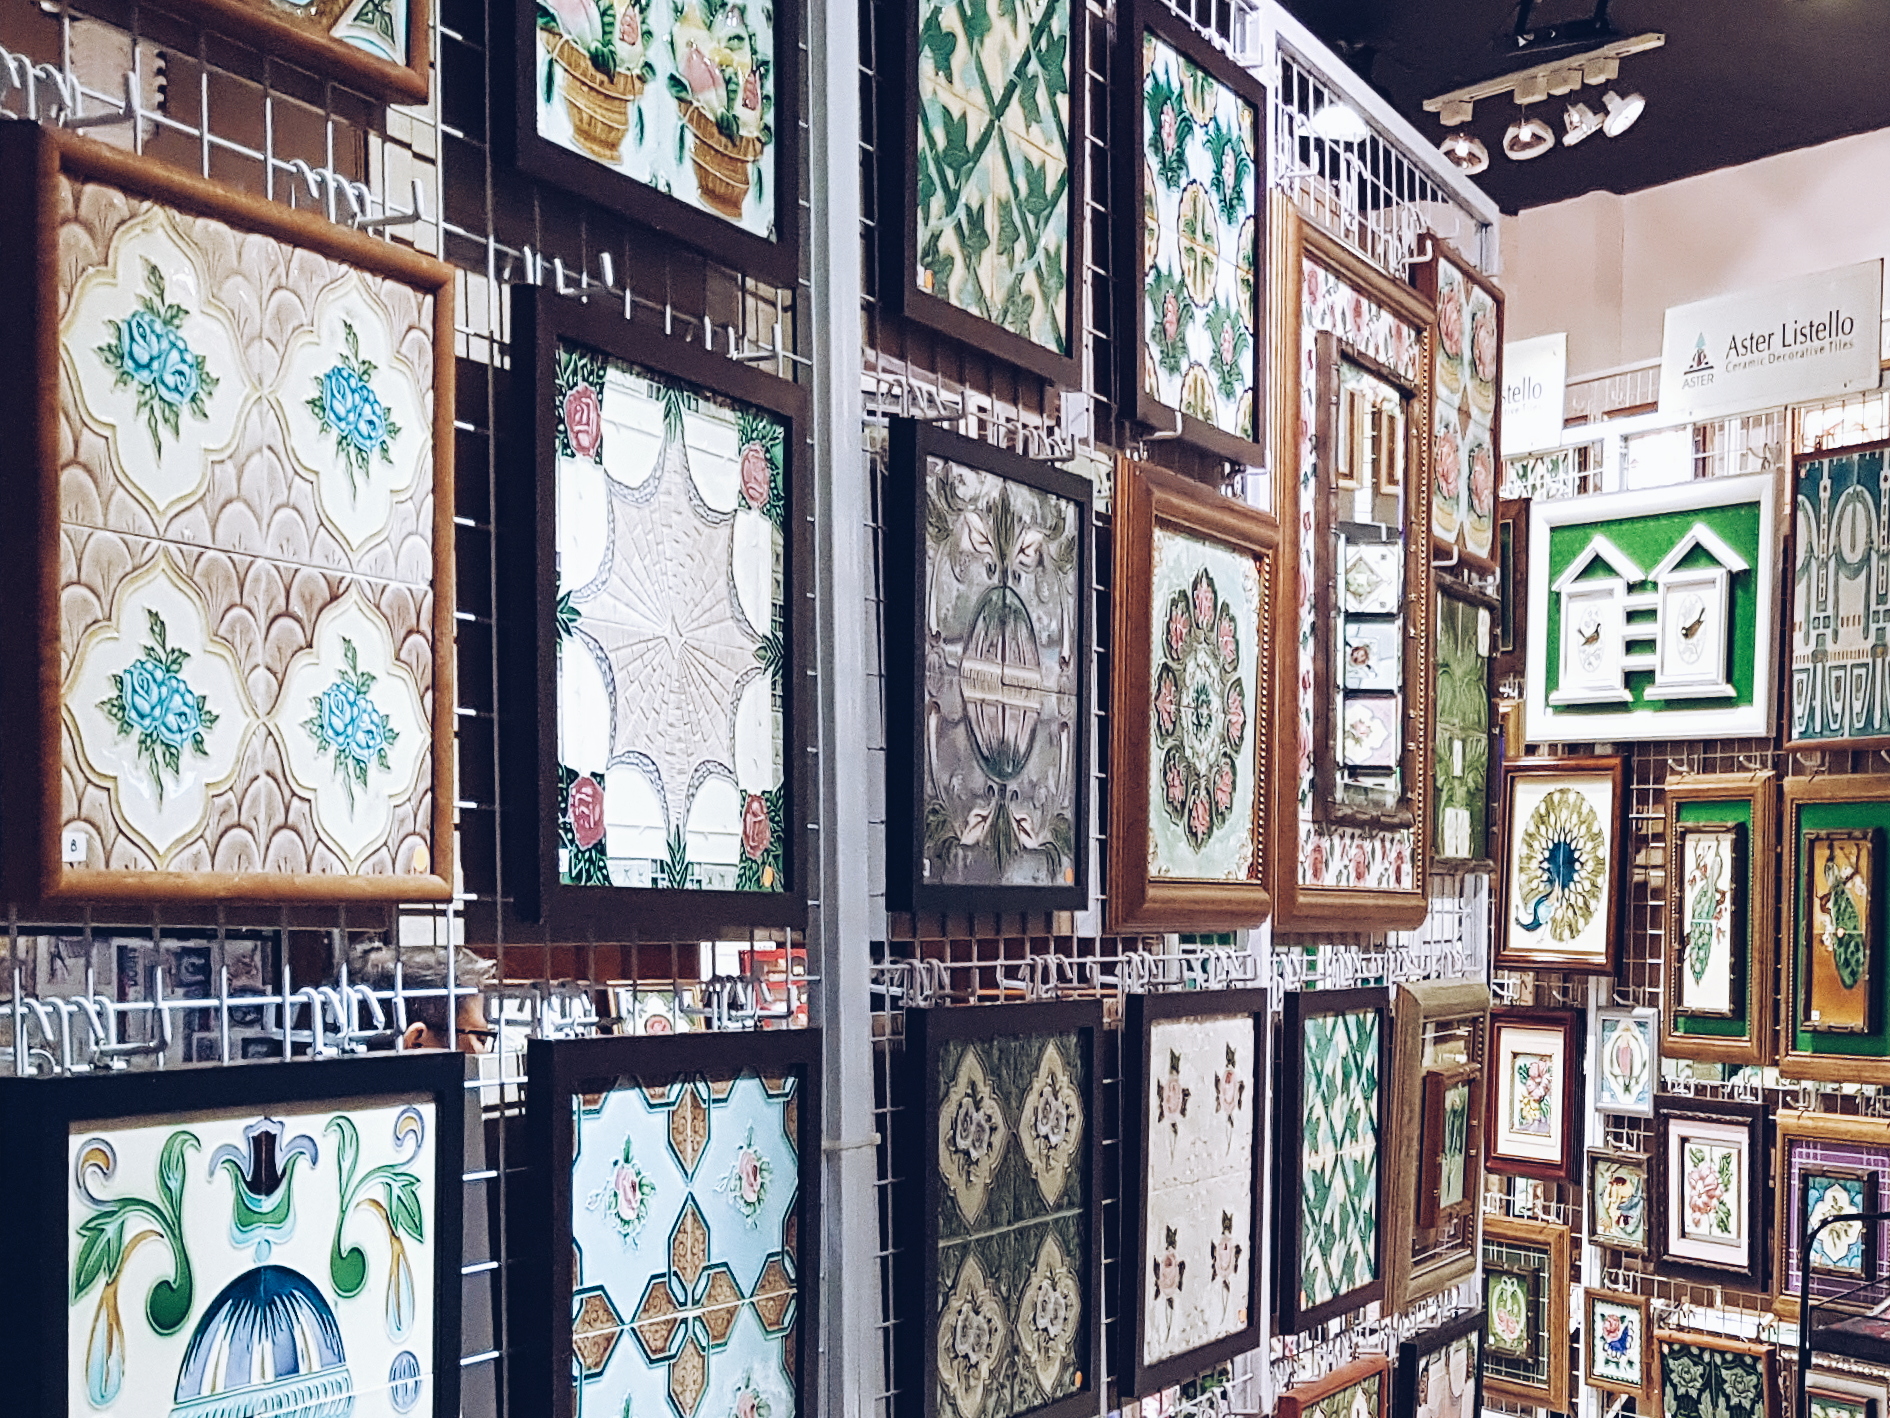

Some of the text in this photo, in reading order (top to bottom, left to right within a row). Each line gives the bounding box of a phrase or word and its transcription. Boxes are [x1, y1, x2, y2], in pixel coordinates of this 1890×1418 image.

[1725, 309, 1855, 360] Aster Listello
[1725, 338, 1855, 374] Ceramic Decorative Tiles
[1682, 373, 1715, 390] ASTER
